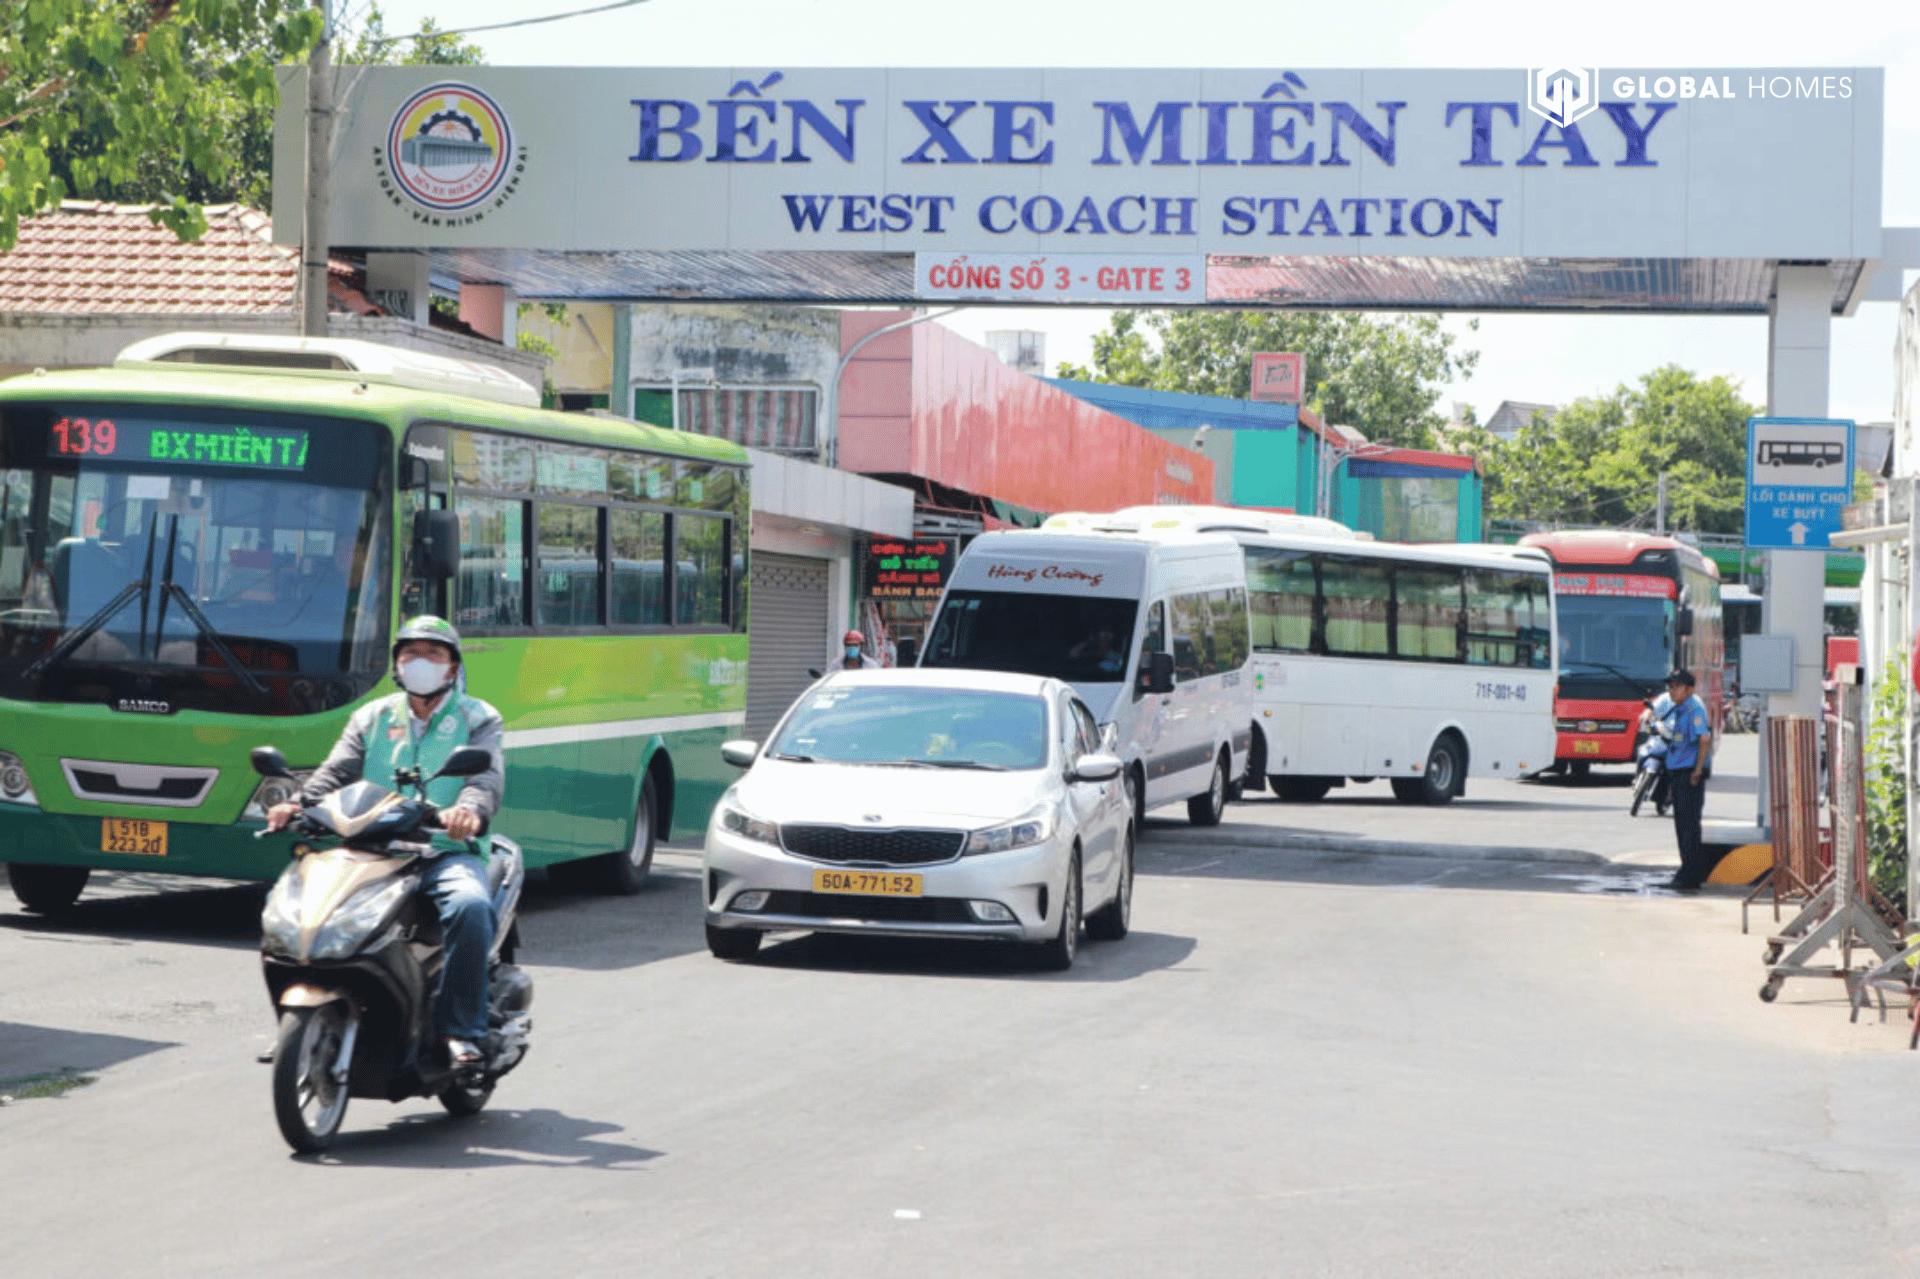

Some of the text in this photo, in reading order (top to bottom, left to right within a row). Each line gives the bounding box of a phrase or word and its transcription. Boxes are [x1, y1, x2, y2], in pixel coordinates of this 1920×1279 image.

[628, 71, 866, 163] BẾN
[901, 100, 1055, 165] XE
[1091, 71, 1407, 167] MIỀN
[782, 194, 1503, 238] WEST COACH STATION
[1054, 266, 1071, 291] 3
[1097, 266, 1165, 291] GATE
[1175, 266, 1191, 291] 3
[52, 418, 117, 455] 139
[151, 430, 189, 459] BX
[119, 699, 169, 713] SAMCO
